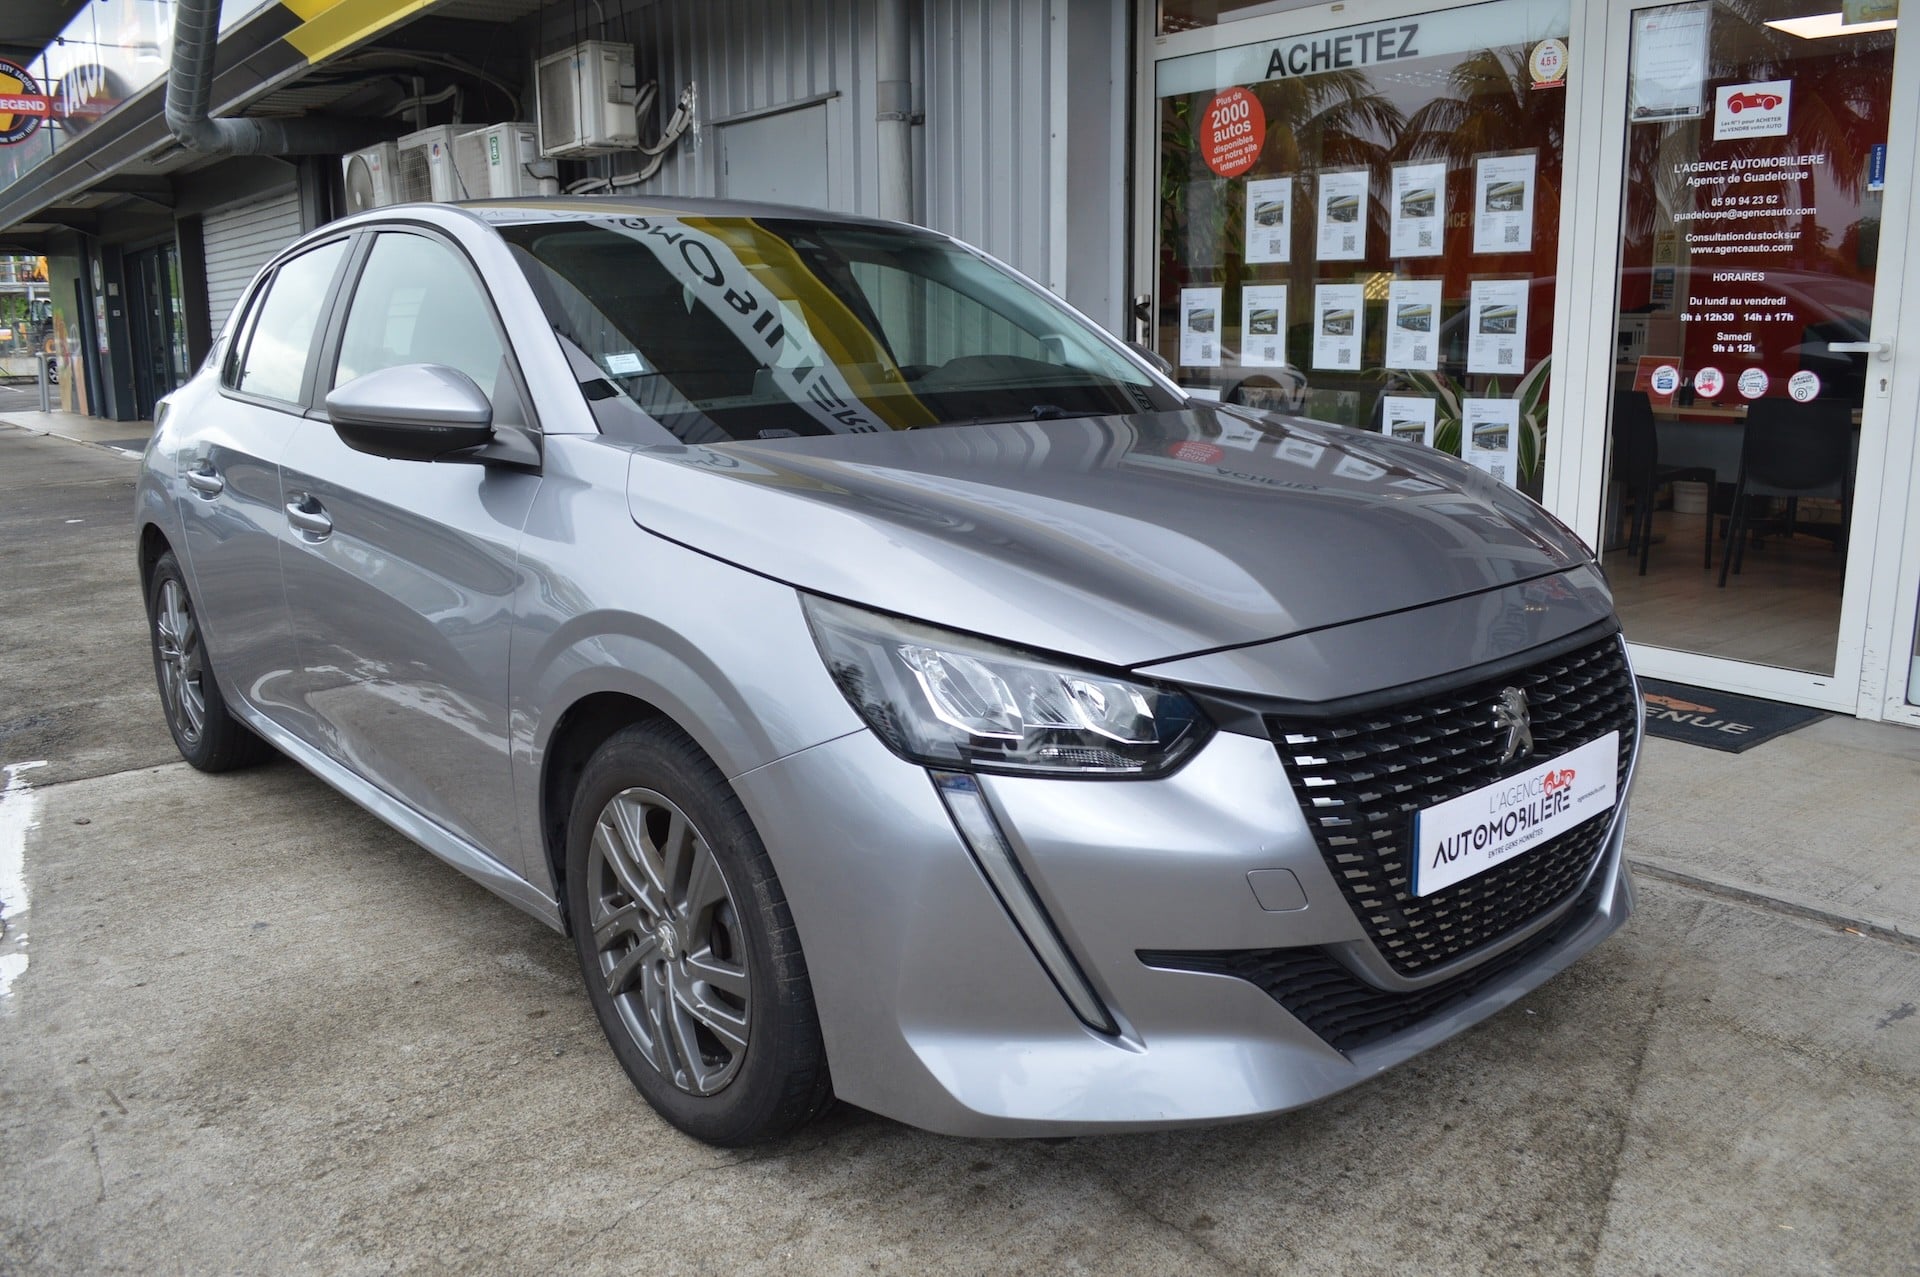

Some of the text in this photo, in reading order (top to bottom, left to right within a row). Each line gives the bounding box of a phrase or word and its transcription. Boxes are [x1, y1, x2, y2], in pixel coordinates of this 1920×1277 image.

[1265, 23, 1419, 79] ACHETEZ
[1216, 92, 1242, 107] Plus de
[1211, 100, 1249, 129] 2000
[1214, 120, 1251, 143] autos
[1214, 135, 1254, 154] disponibles
[1212, 143, 1258, 165] sur notre site
[1220, 157, 1247, 171] internet
[1674, 154, 1825, 173] L'AGENCE AUTOMOBILIERE
[1686, 171, 1809, 188] Agence de Guadeloupe
[1711, 195, 1778, 207] 05 90 94 23 62
[1673, 207, 1817, 222] guadeloupe@agenceauto.com
[1690, 244, 1793, 255] www.agenceauto.com
[1712, 272, 1765, 282] HORAIRES
[1689, 297, 1702, 306] Du
[1704, 297, 1728, 306] lundi
[1744, 297, 1786, 306] vendredi
[1680, 313, 1794, 321] 9h à 12h30 14h à 17h
[1716, 332, 1752, 341] Samedi
[1712, 344, 1756, 352] 9h à 12h
[1490, 774, 1546, 814] L'AGENCE
[1488, 845, 1505, 859] ENTRE
[1505, 839, 1519, 853] GENS
